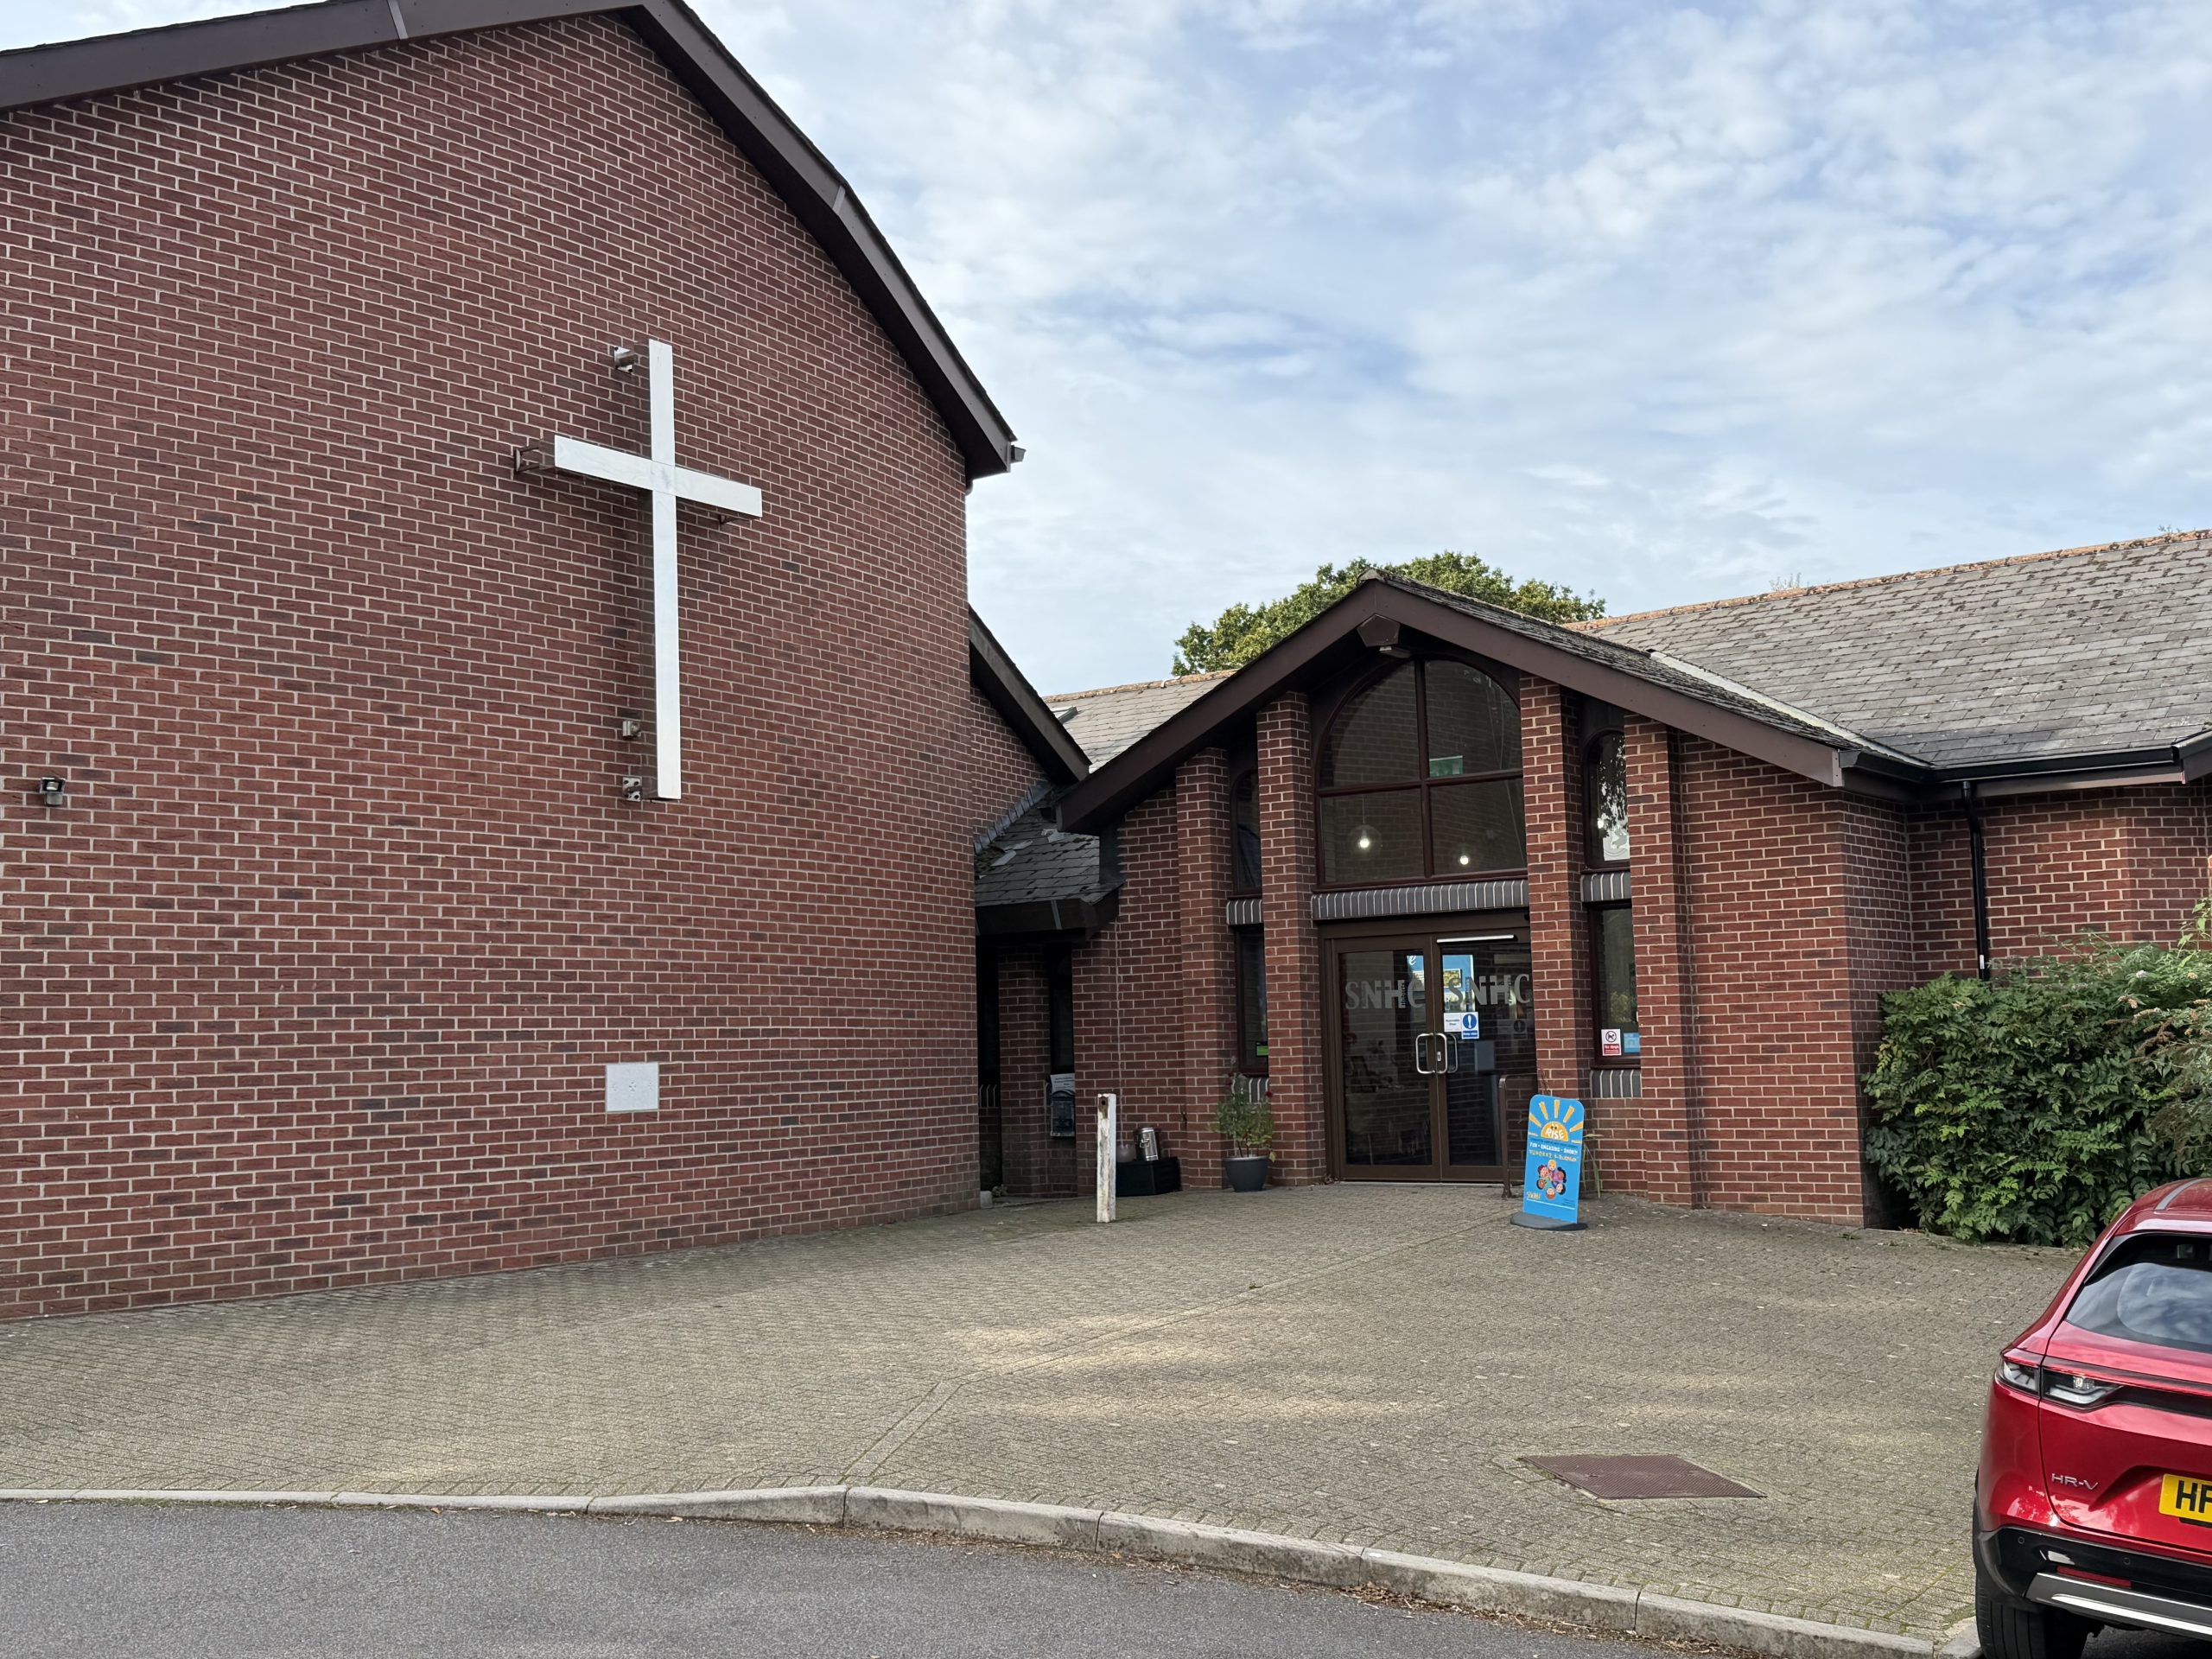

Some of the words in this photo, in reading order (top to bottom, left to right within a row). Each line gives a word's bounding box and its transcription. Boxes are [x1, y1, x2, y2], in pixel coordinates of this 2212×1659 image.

[1345, 980, 1426, 1009] SNHC
[1448, 974, 1530, 1006] SNHC
[1546, 1128, 1564, 1140] RISE
[2051, 1473, 2099, 1491] HR-V
